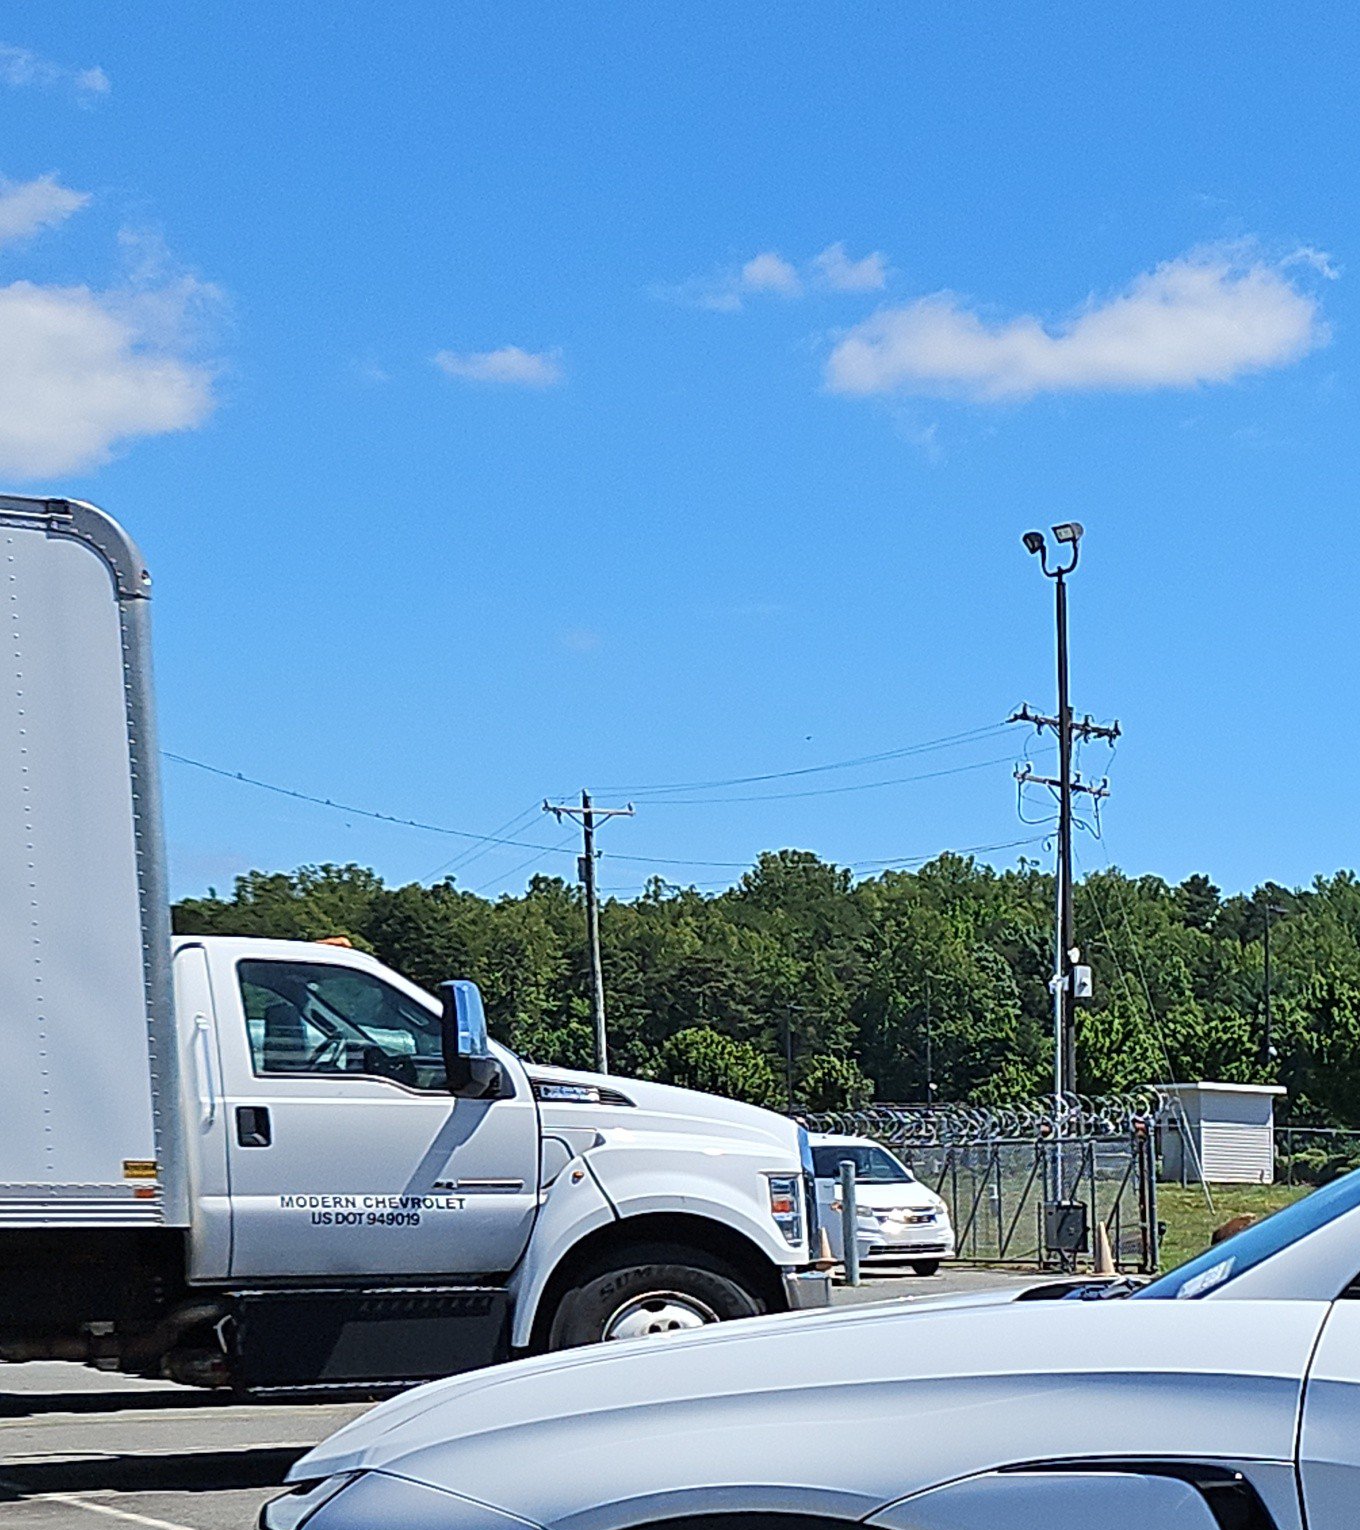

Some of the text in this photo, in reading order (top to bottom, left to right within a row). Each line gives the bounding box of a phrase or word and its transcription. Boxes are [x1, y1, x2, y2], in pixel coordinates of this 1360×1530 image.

[280, 1196, 466, 1210] MODERN CHEVROLET
[311, 1211, 420, 1226] US DOT 949019
